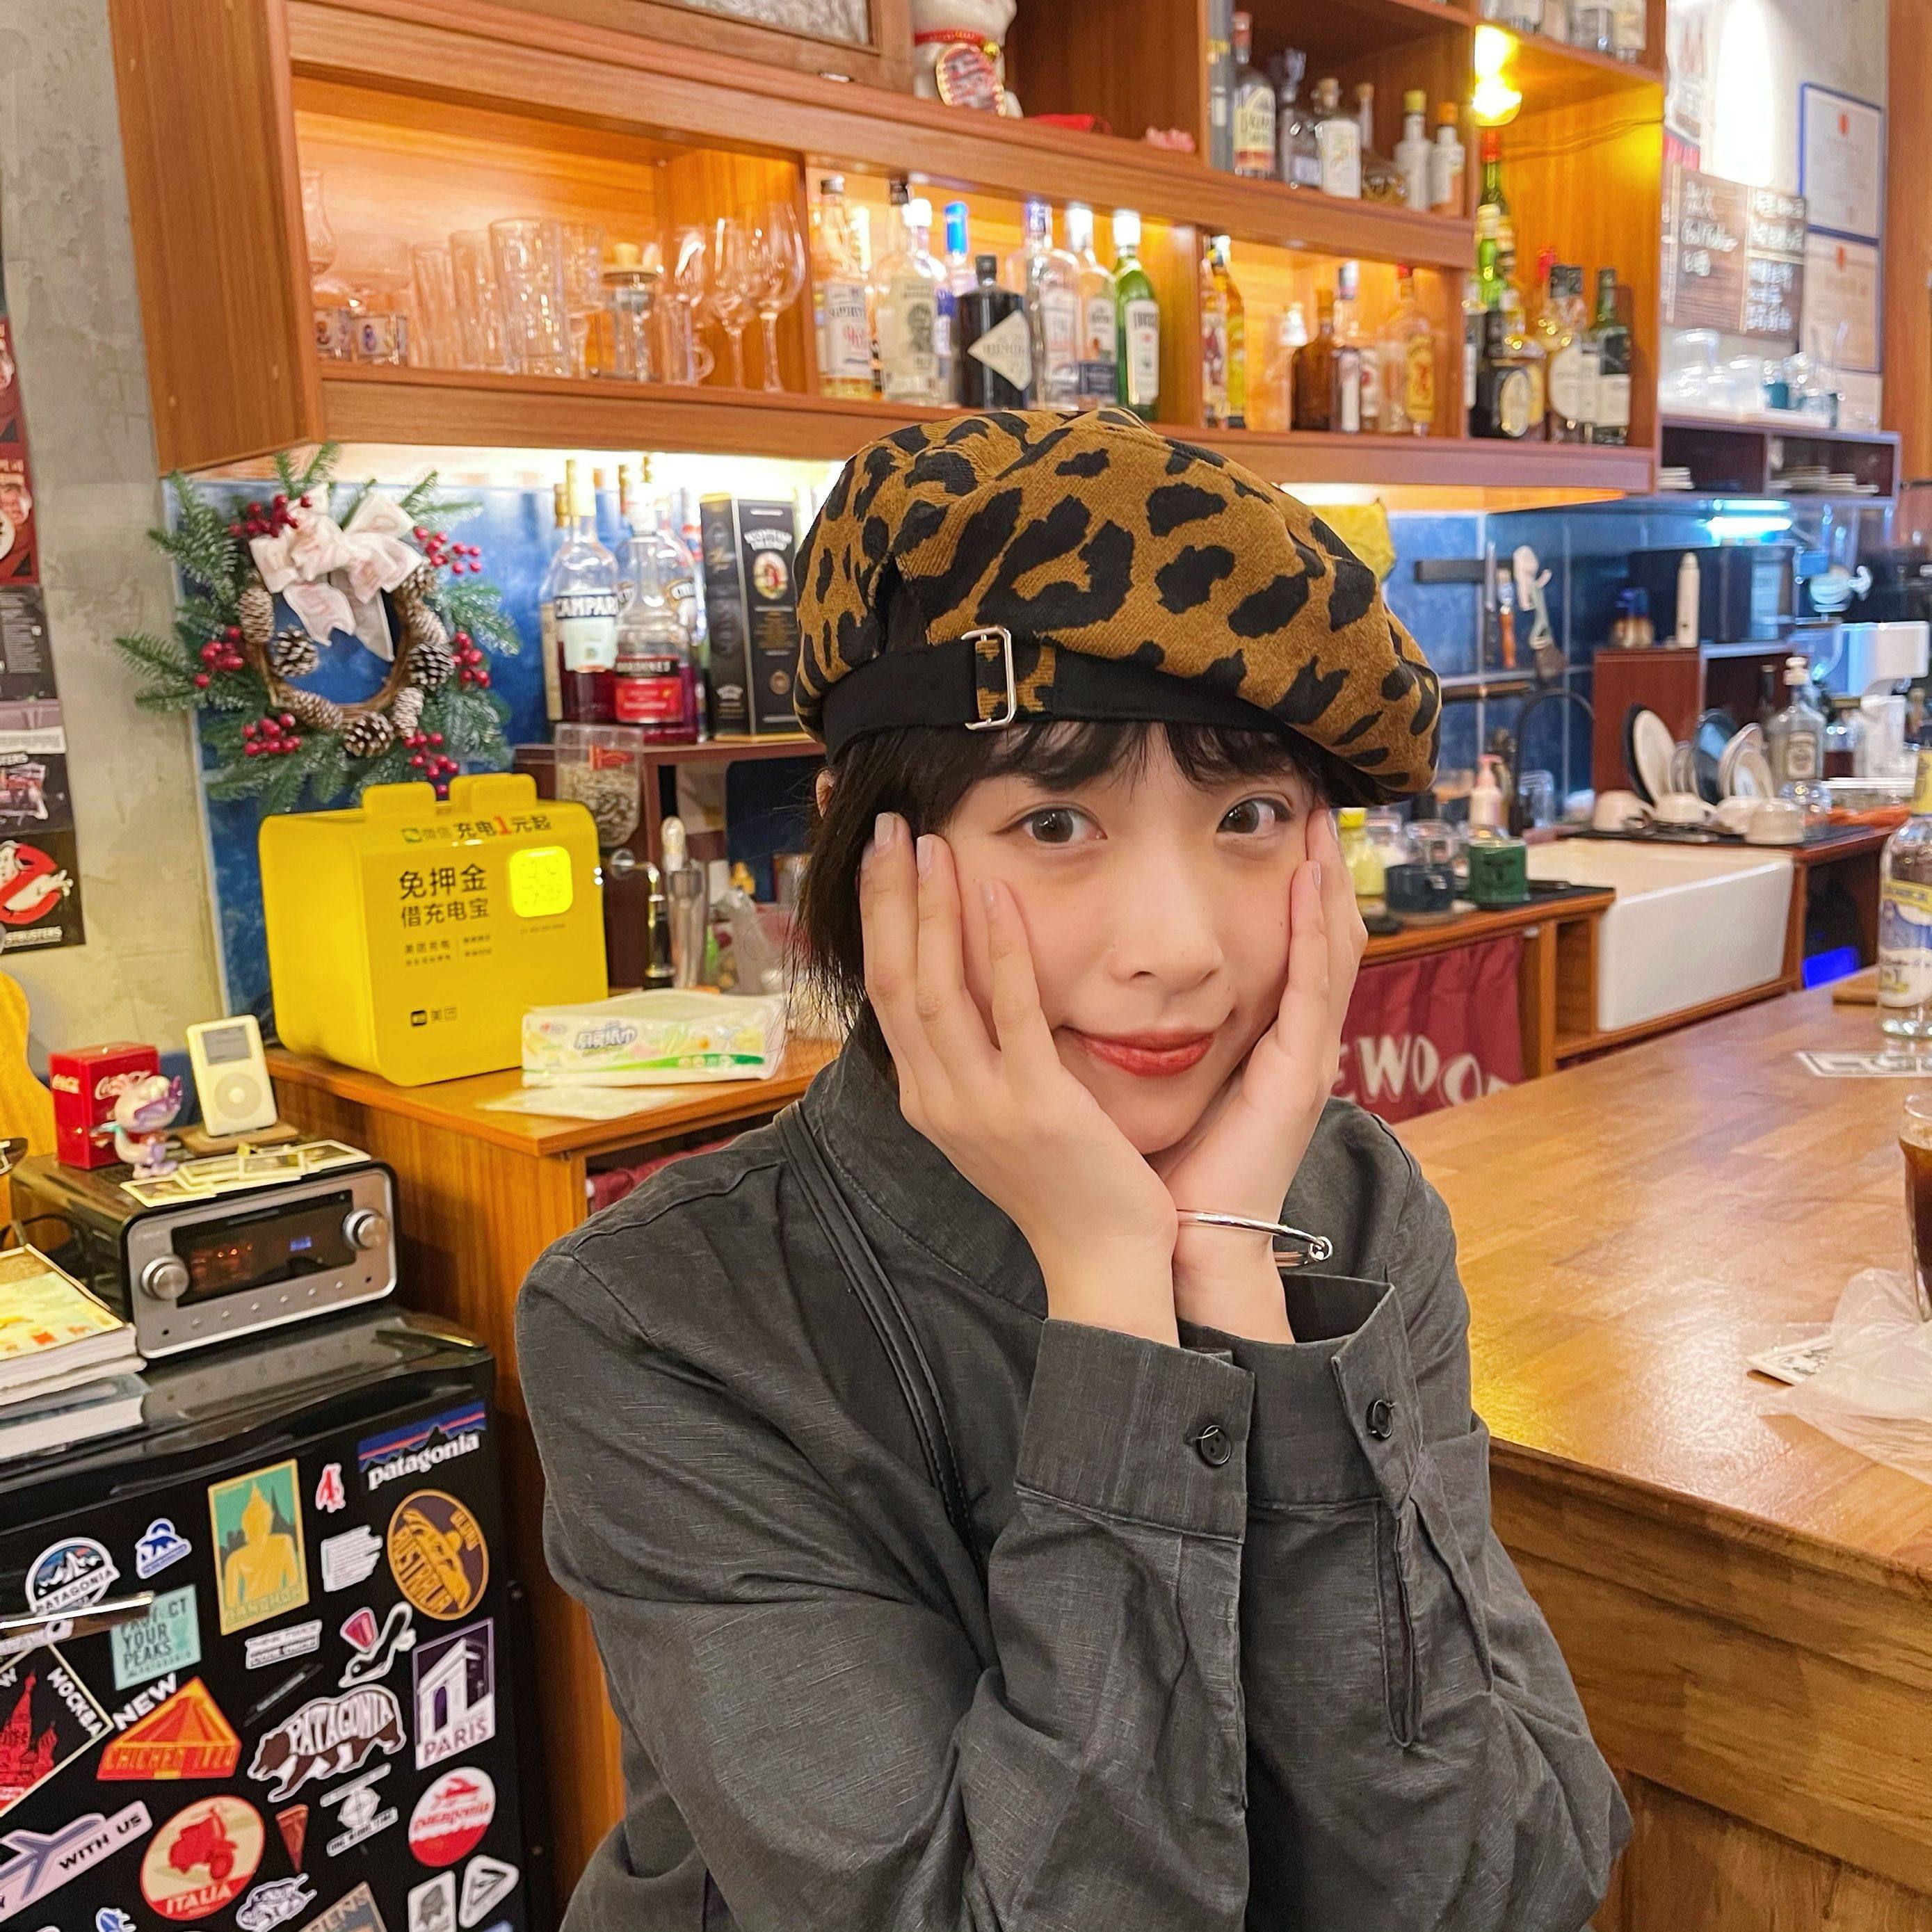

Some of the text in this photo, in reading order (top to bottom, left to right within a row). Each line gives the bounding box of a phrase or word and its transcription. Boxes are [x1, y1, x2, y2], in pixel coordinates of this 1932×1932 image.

[454, 815, 552, 839] 充电1元起
[399, 863, 487, 900] 免押金
[401, 898, 490, 929] 借充电宝
[368, 1433, 480, 1491] patagonia
[35, 1569, 114, 1614] PATAGONIA
[121, 1624, 168, 1652] YOUR
[124, 1641, 172, 1670] PEAKS
[113, 1672, 177, 1731] NEW
[286, 1691, 395, 1756] PATAGONIA
[424, 1716, 488, 1761] PARIS
[59, 1814, 141, 1870] WITH US
[166, 1883, 233, 1915] ITALIA
